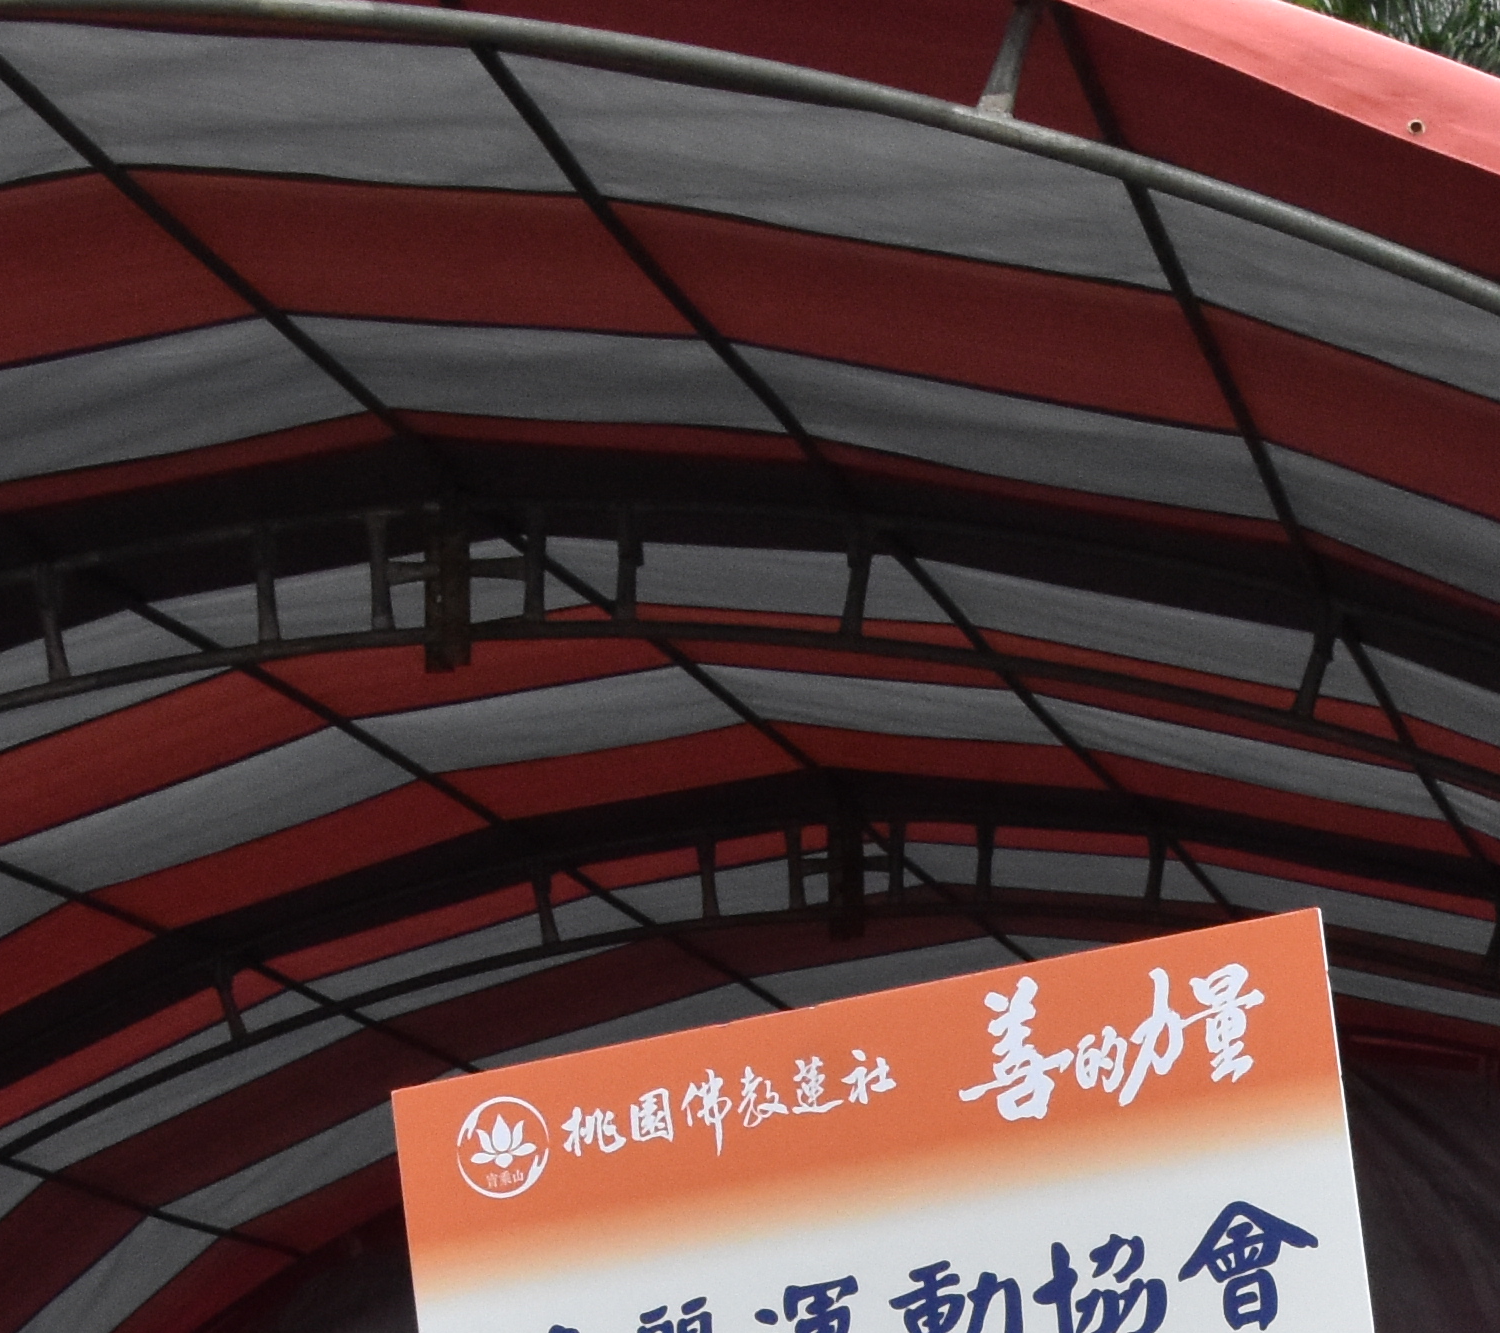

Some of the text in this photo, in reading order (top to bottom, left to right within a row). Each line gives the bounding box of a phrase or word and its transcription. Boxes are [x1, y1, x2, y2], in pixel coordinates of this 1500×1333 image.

[560, 1049, 897, 1157] 桃園佛教蓮社
[958, 962, 1265, 1121] 善的力量
